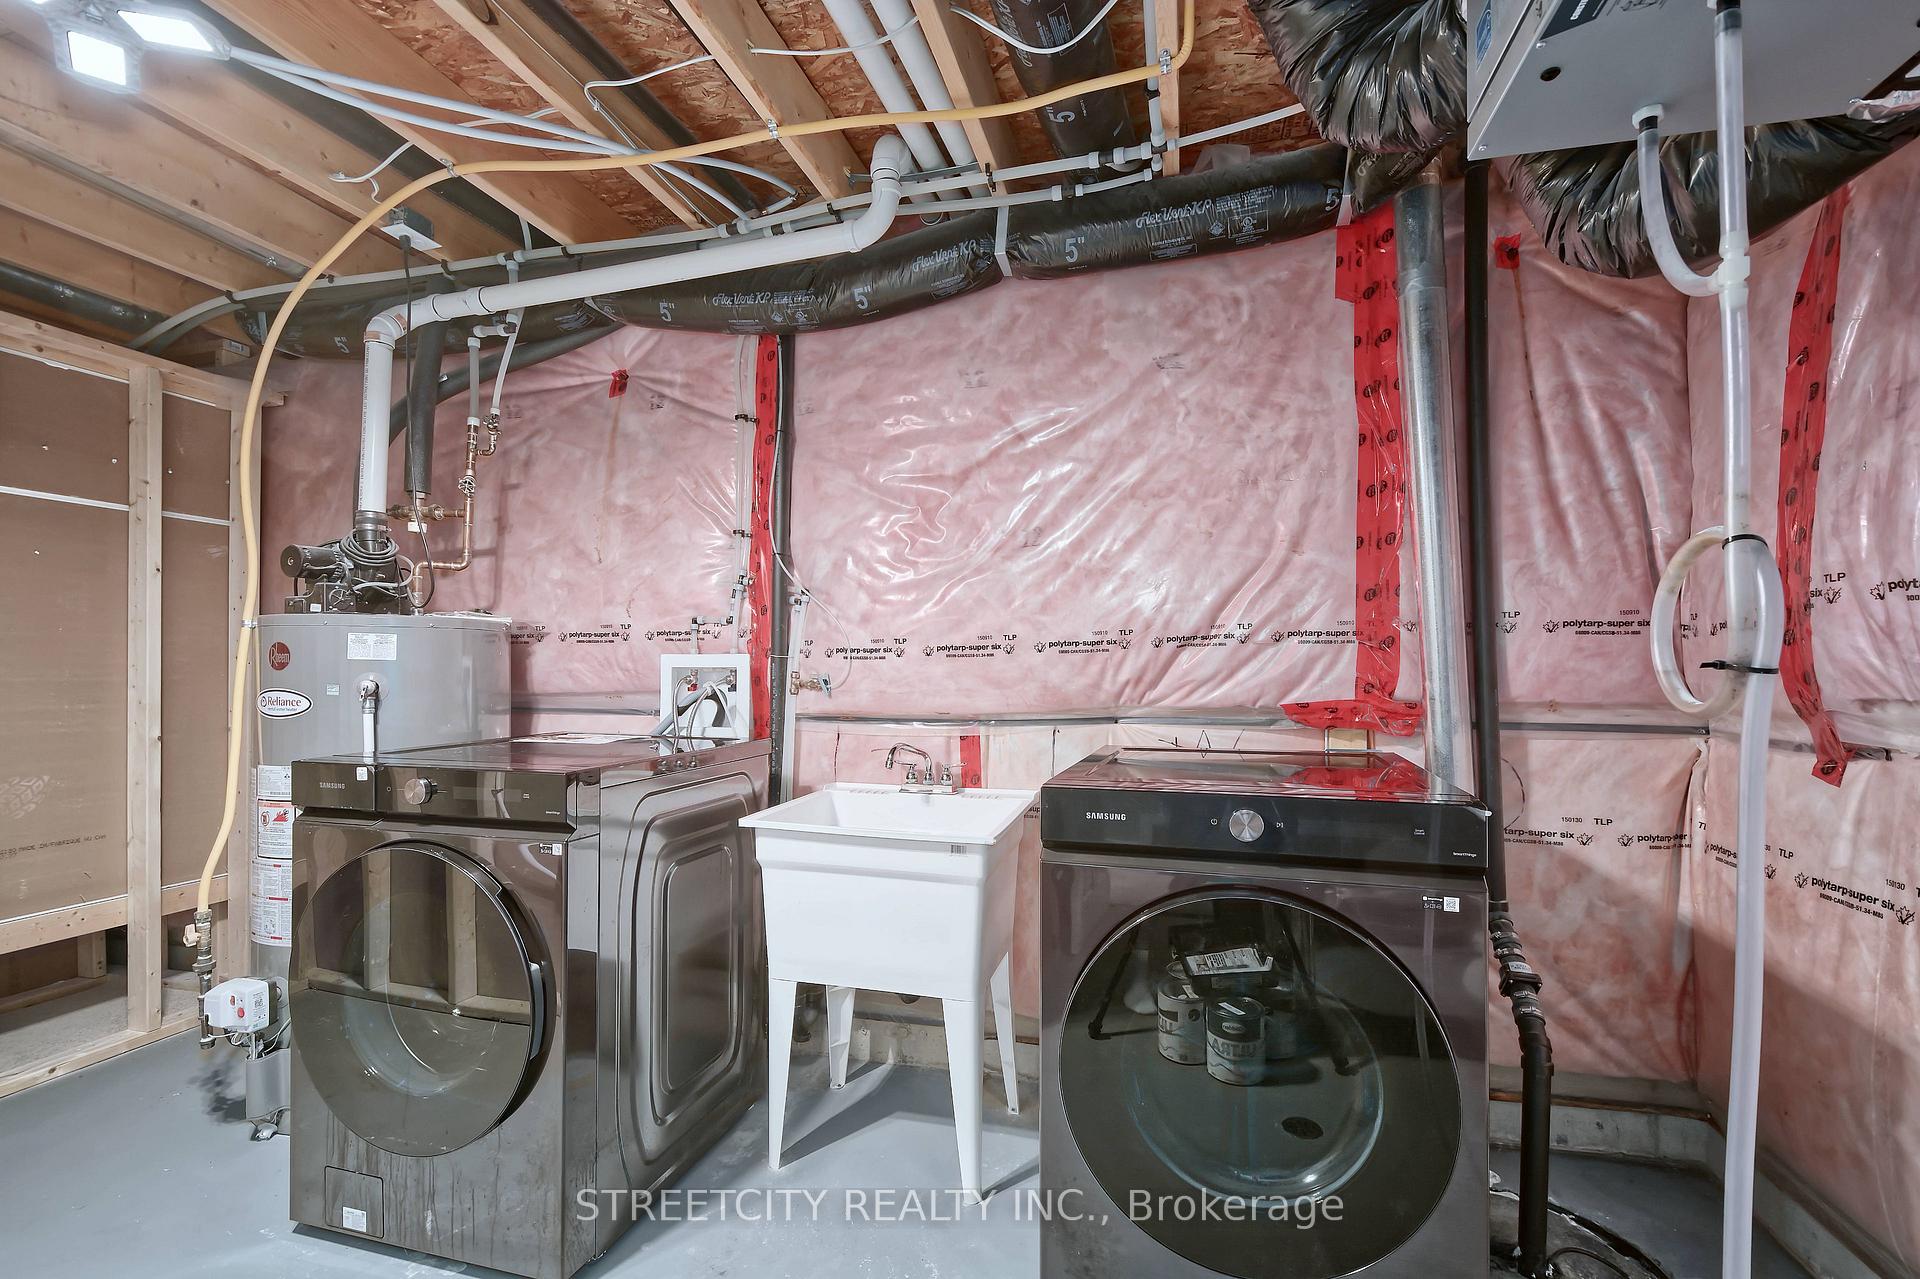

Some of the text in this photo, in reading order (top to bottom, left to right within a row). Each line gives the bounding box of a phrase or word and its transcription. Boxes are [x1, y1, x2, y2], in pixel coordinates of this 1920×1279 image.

[1065, 236, 1085, 263] 5"
[852, 284, 872, 310] 5"
[1823, 572, 1846, 583] TLP
[1502, 611, 1521, 619] TLP
[1562, 619, 1651, 632] polytarp-super six
[1166, 632, 1236, 643] polytarp-super six
[1287, 629, 1350, 639] polytarp-super
[936, 644, 990, 653] polytarp-super
[1048, 638, 1118, 649] polytarp-super six
[270, 642, 290, 667] Rheem
[835, 647, 882, 655] polyarp-super
[267, 696, 302, 707] Reliance
[319, 782, 346, 790] SAMSUNG
[1085, 811, 1127, 821] SAMSUNG
[1593, 818, 1613, 826] TLP
[1560, 830, 1575, 839] six
[1779, 848, 1794, 859] TLP
[1881, 899, 1896, 912] six
